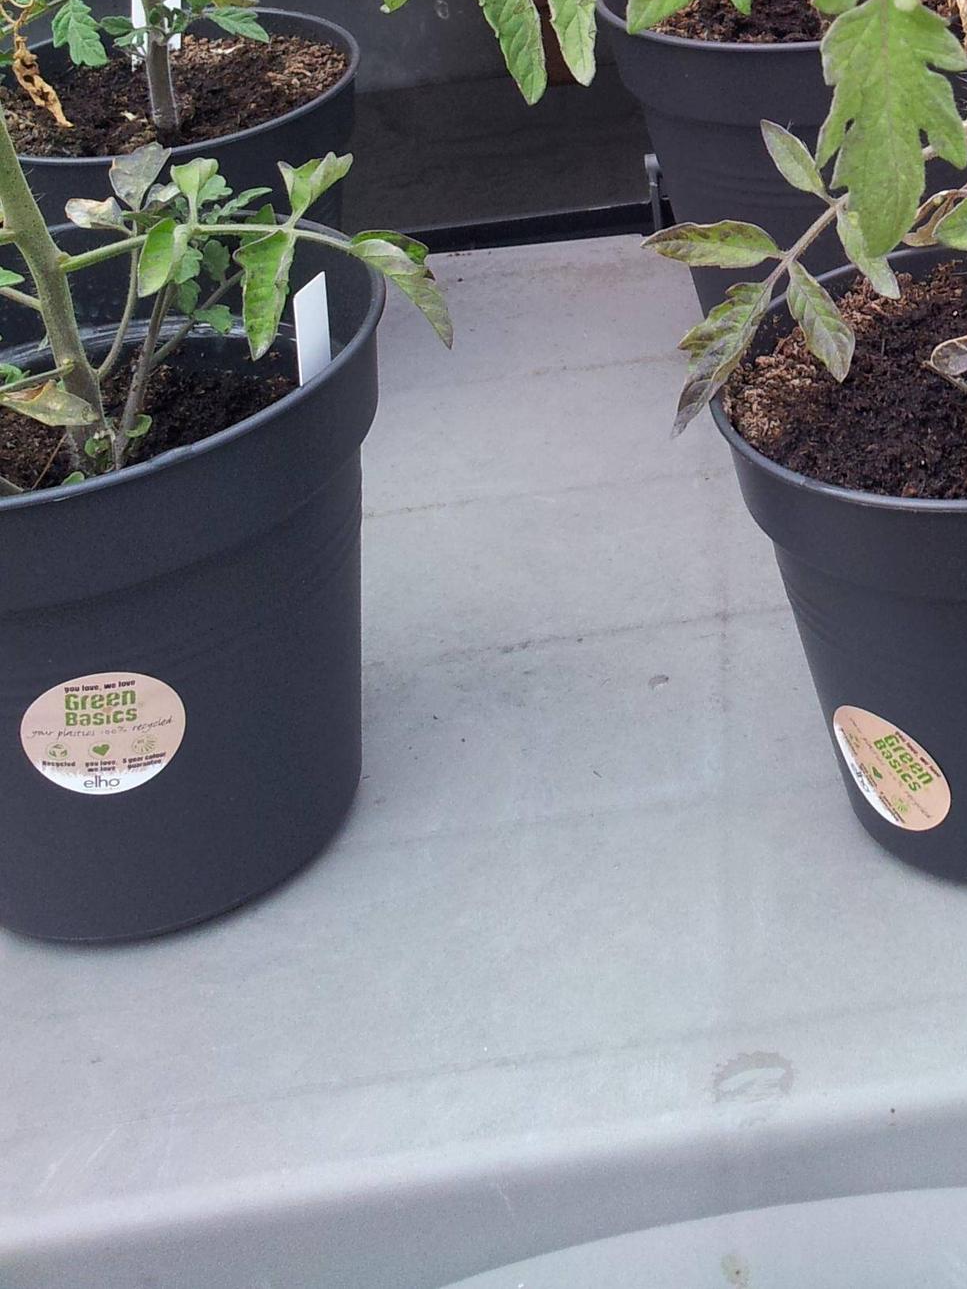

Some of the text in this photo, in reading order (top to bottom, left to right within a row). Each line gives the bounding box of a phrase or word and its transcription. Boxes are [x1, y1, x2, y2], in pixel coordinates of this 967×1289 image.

[64, 690, 136, 711] Green
[65, 708, 137, 727] Basics
[874, 738, 921, 791] Basics
[884, 734, 933, 785] Green
[84, 775, 120, 788] elho
